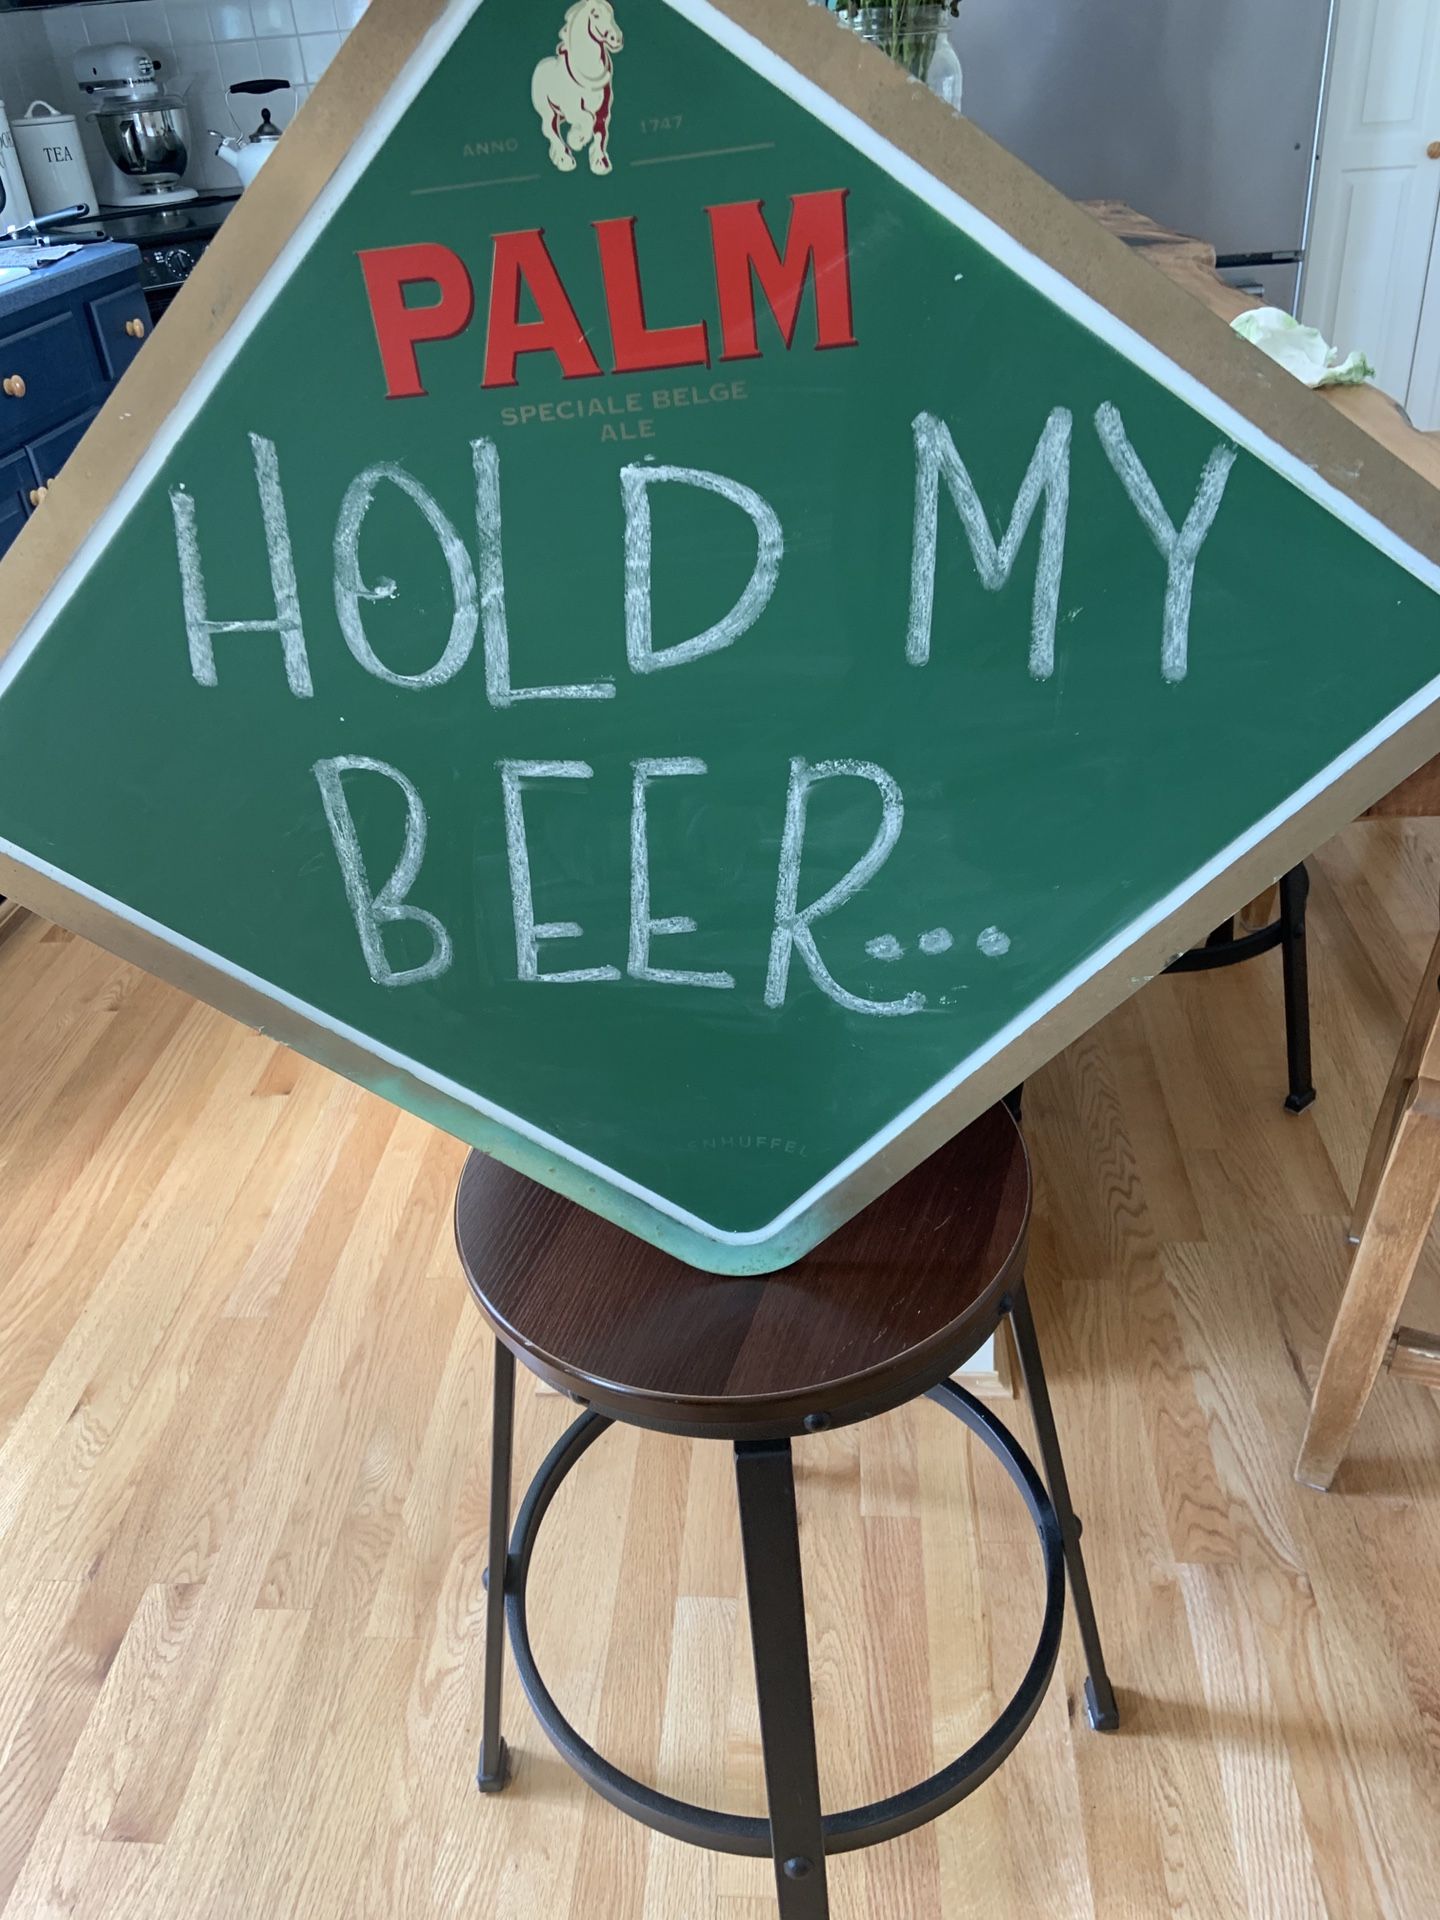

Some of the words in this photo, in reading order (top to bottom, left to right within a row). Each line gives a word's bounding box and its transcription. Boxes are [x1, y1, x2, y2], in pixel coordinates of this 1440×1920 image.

[43, 146, 73, 163] TEA
[462, 137, 519, 158] ANNO
[639, 115, 684, 133] 1747
[356, 188, 859, 400] PALM
[500, 391, 644, 427] SPECIALE
[651, 380, 749, 410] BELGE
[599, 419, 657, 442] ALE
[169, 431, 784, 708] HOLD
[905, 401, 1238, 682] MY
[312, 755, 1011, 1017] BEER...
